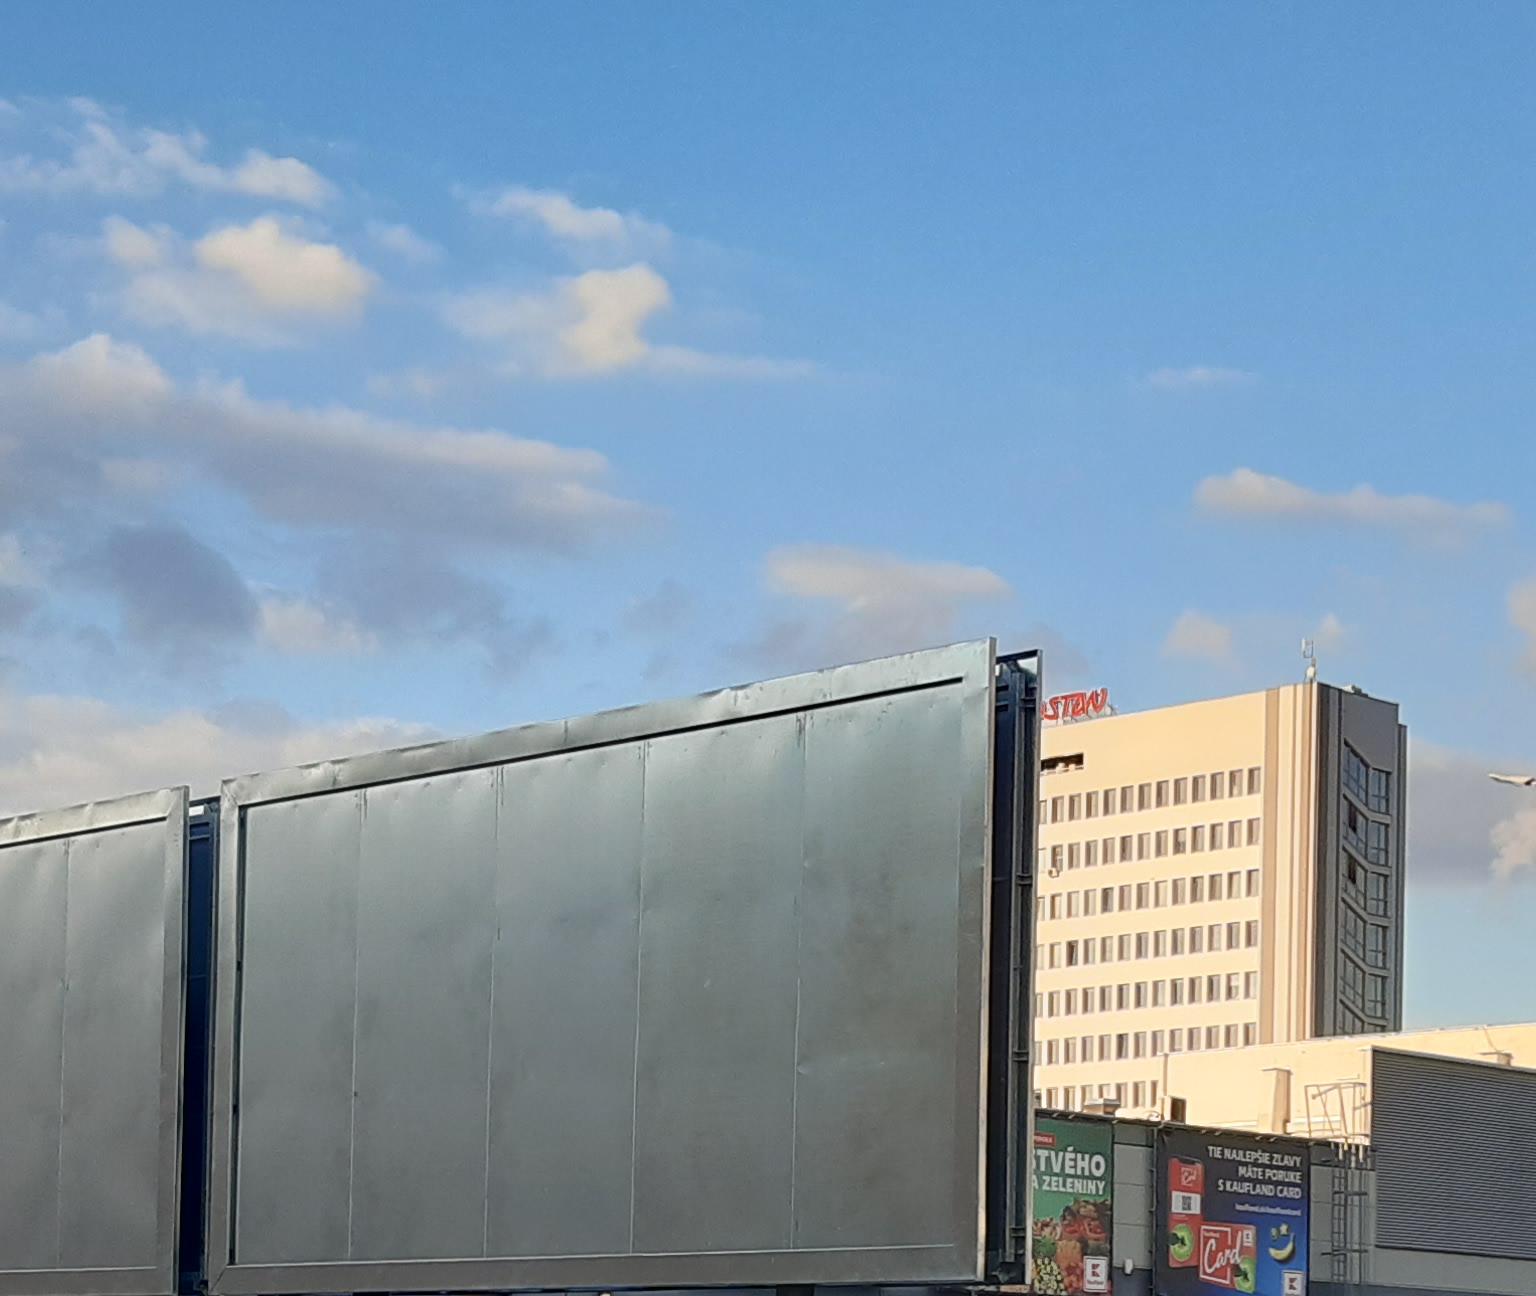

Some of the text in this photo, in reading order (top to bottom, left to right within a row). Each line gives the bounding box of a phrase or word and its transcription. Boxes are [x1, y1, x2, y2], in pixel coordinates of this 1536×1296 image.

[1208, 1146, 1222, 1158] TIE
[1042, 1175, 1106, 1195] ZELENINY
[1217, 1179, 1302, 1199] S KAUFLAND CARD
[1204, 1230, 1241, 1273] Card
